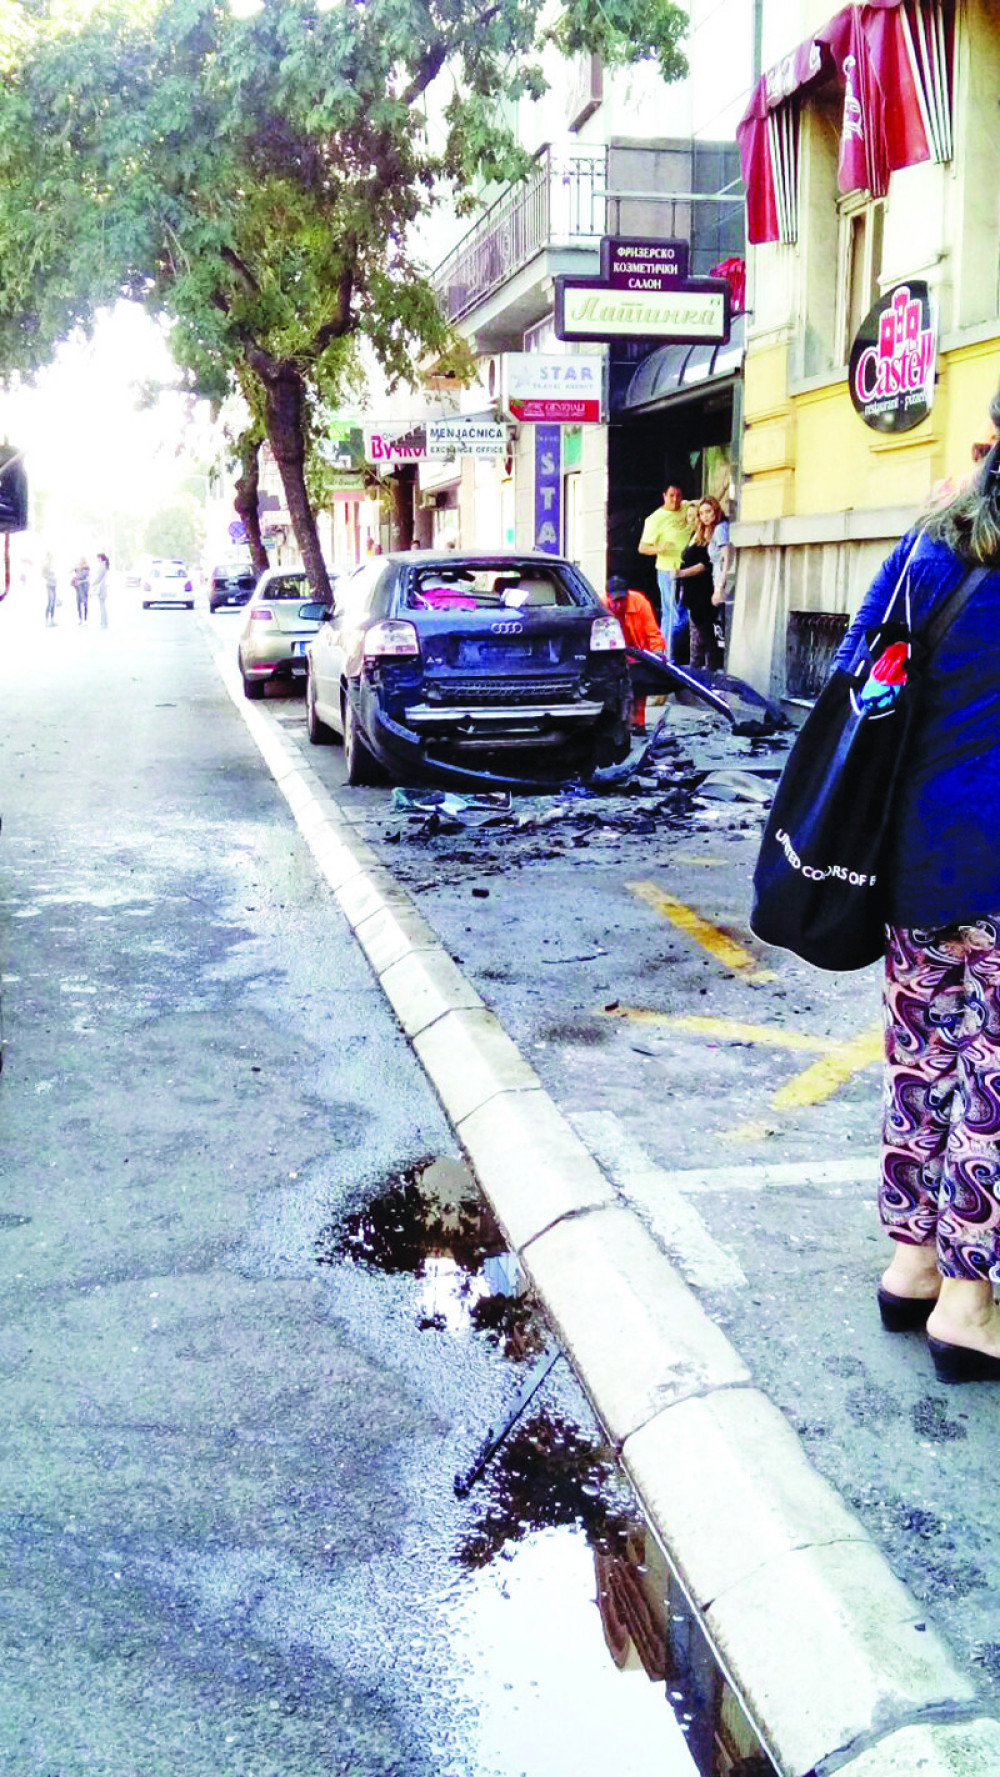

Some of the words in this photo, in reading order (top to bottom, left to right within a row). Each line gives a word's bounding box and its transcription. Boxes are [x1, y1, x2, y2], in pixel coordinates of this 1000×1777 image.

[616, 246, 675, 259] ФРИЗЕРСКО
[613, 262, 678, 275] КОЗМЕТИЧКИ
[628, 278, 662, 290] САЛОН
[540, 365, 593, 380] STAR
[856, 328, 933, 403] Castell
[801, 865, 848, 881] COORS
[848, 871, 867, 886] OF
